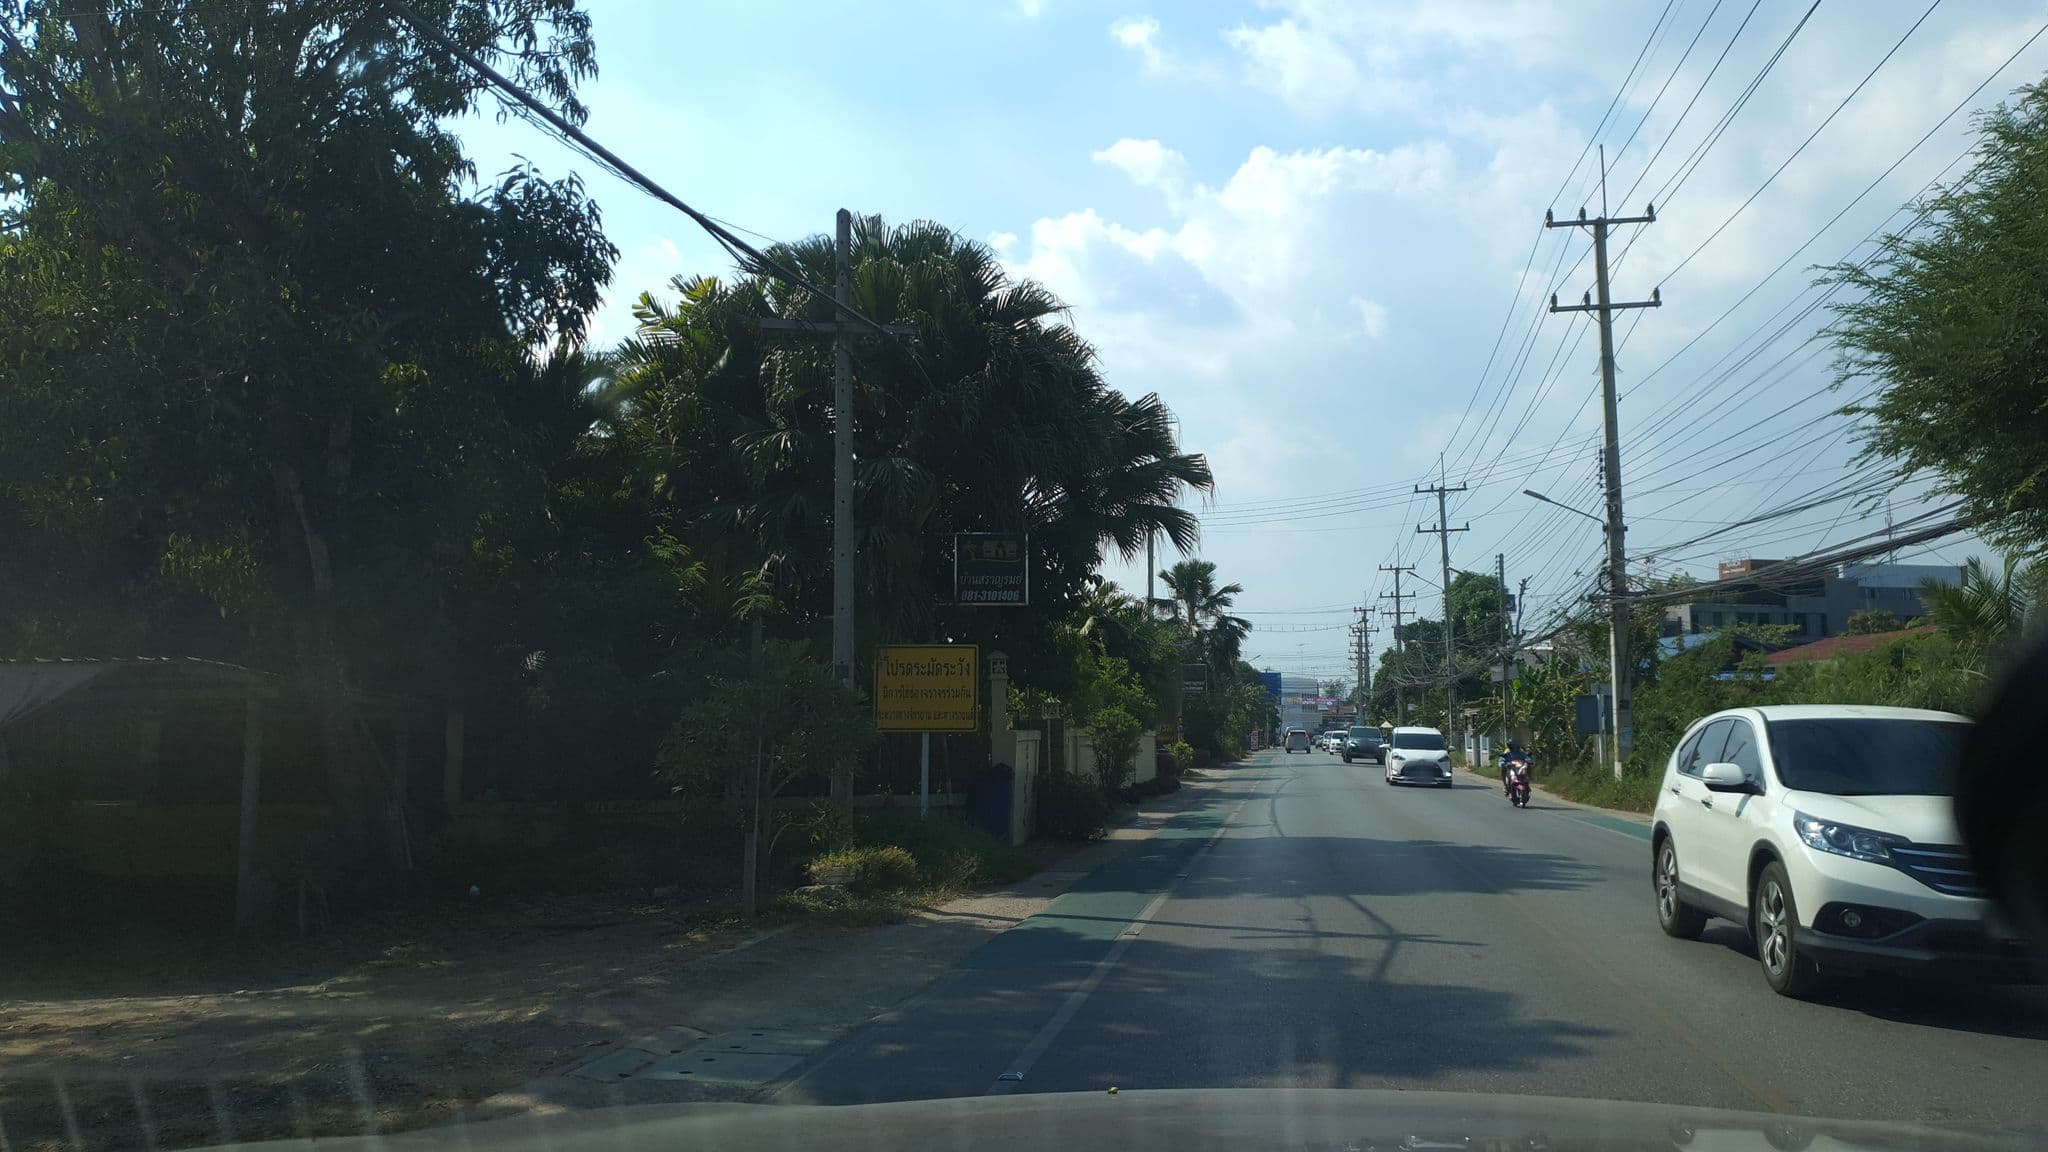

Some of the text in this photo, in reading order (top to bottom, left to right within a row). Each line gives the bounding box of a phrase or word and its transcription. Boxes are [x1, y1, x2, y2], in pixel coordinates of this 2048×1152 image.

[880, 656, 971, 677] โปรดระมัดระวัง
